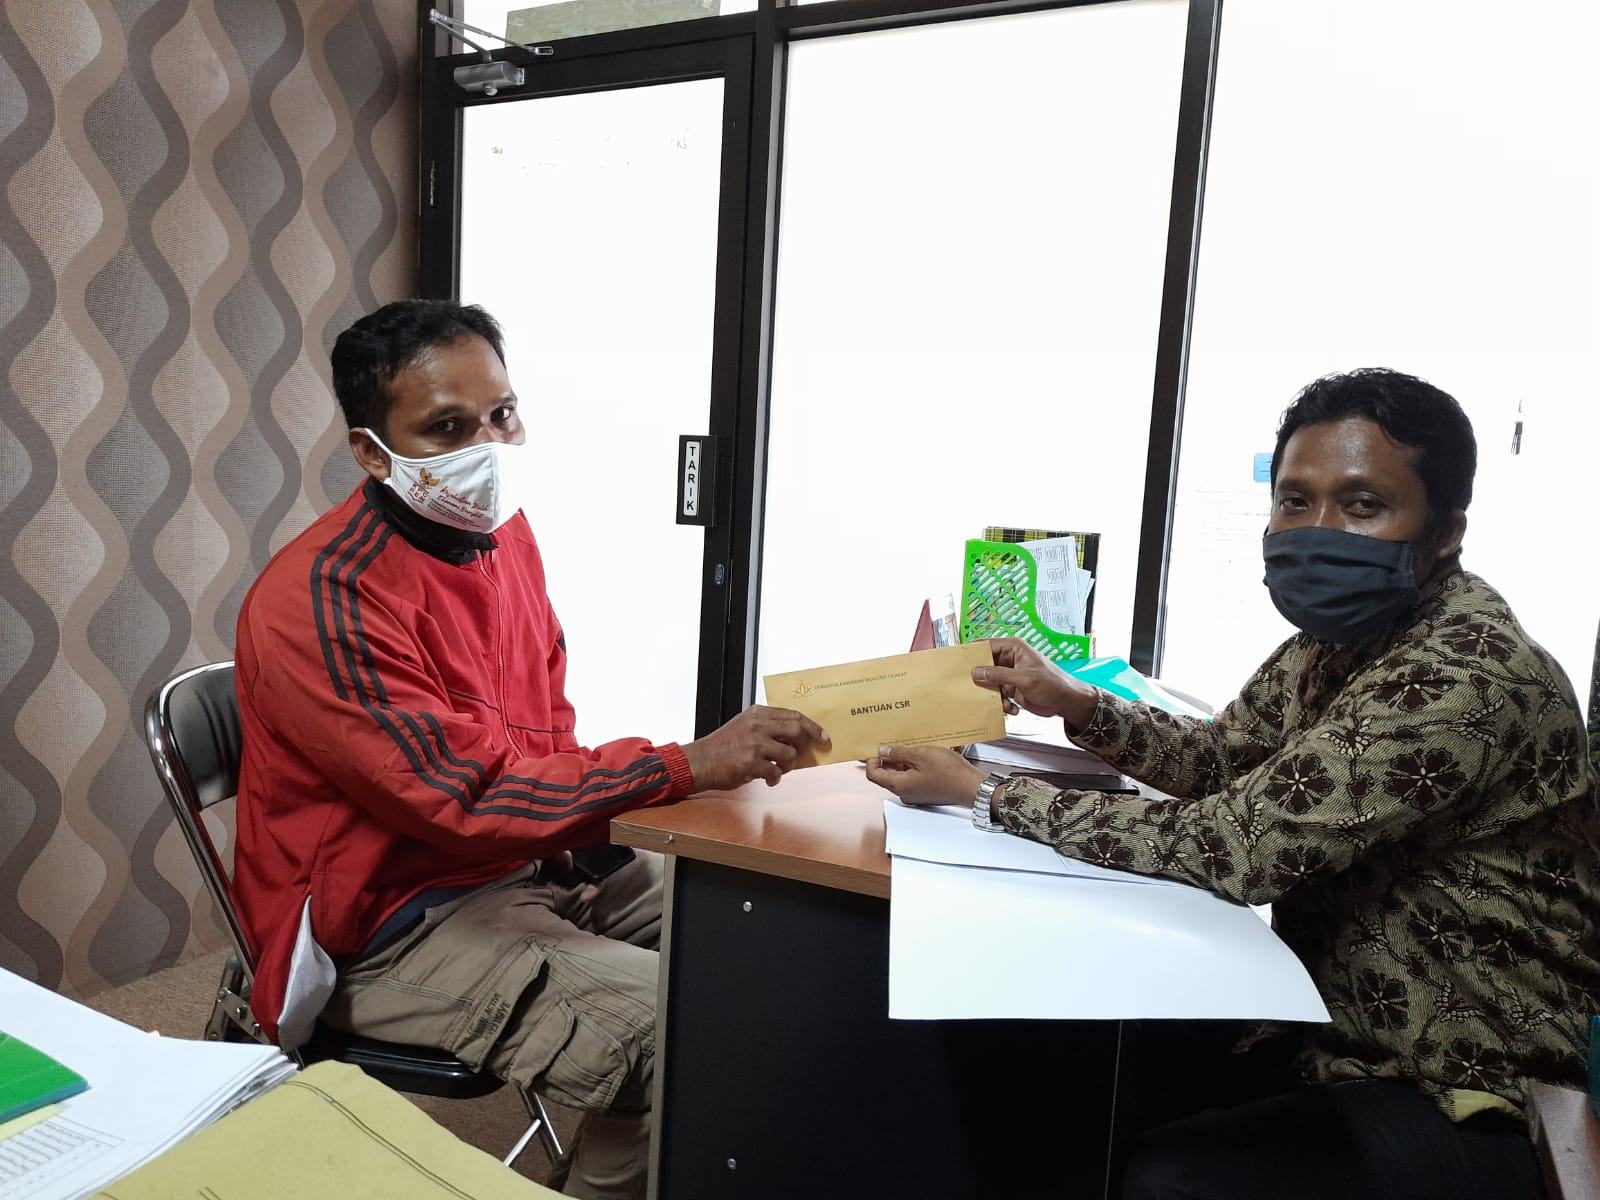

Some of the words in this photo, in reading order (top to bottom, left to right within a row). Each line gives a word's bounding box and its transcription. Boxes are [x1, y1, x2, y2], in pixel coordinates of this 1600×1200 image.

[686, 446, 697, 511] TARIK
[850, 703, 893, 716] BANTUAN
[894, 700, 911, 709] CSR
